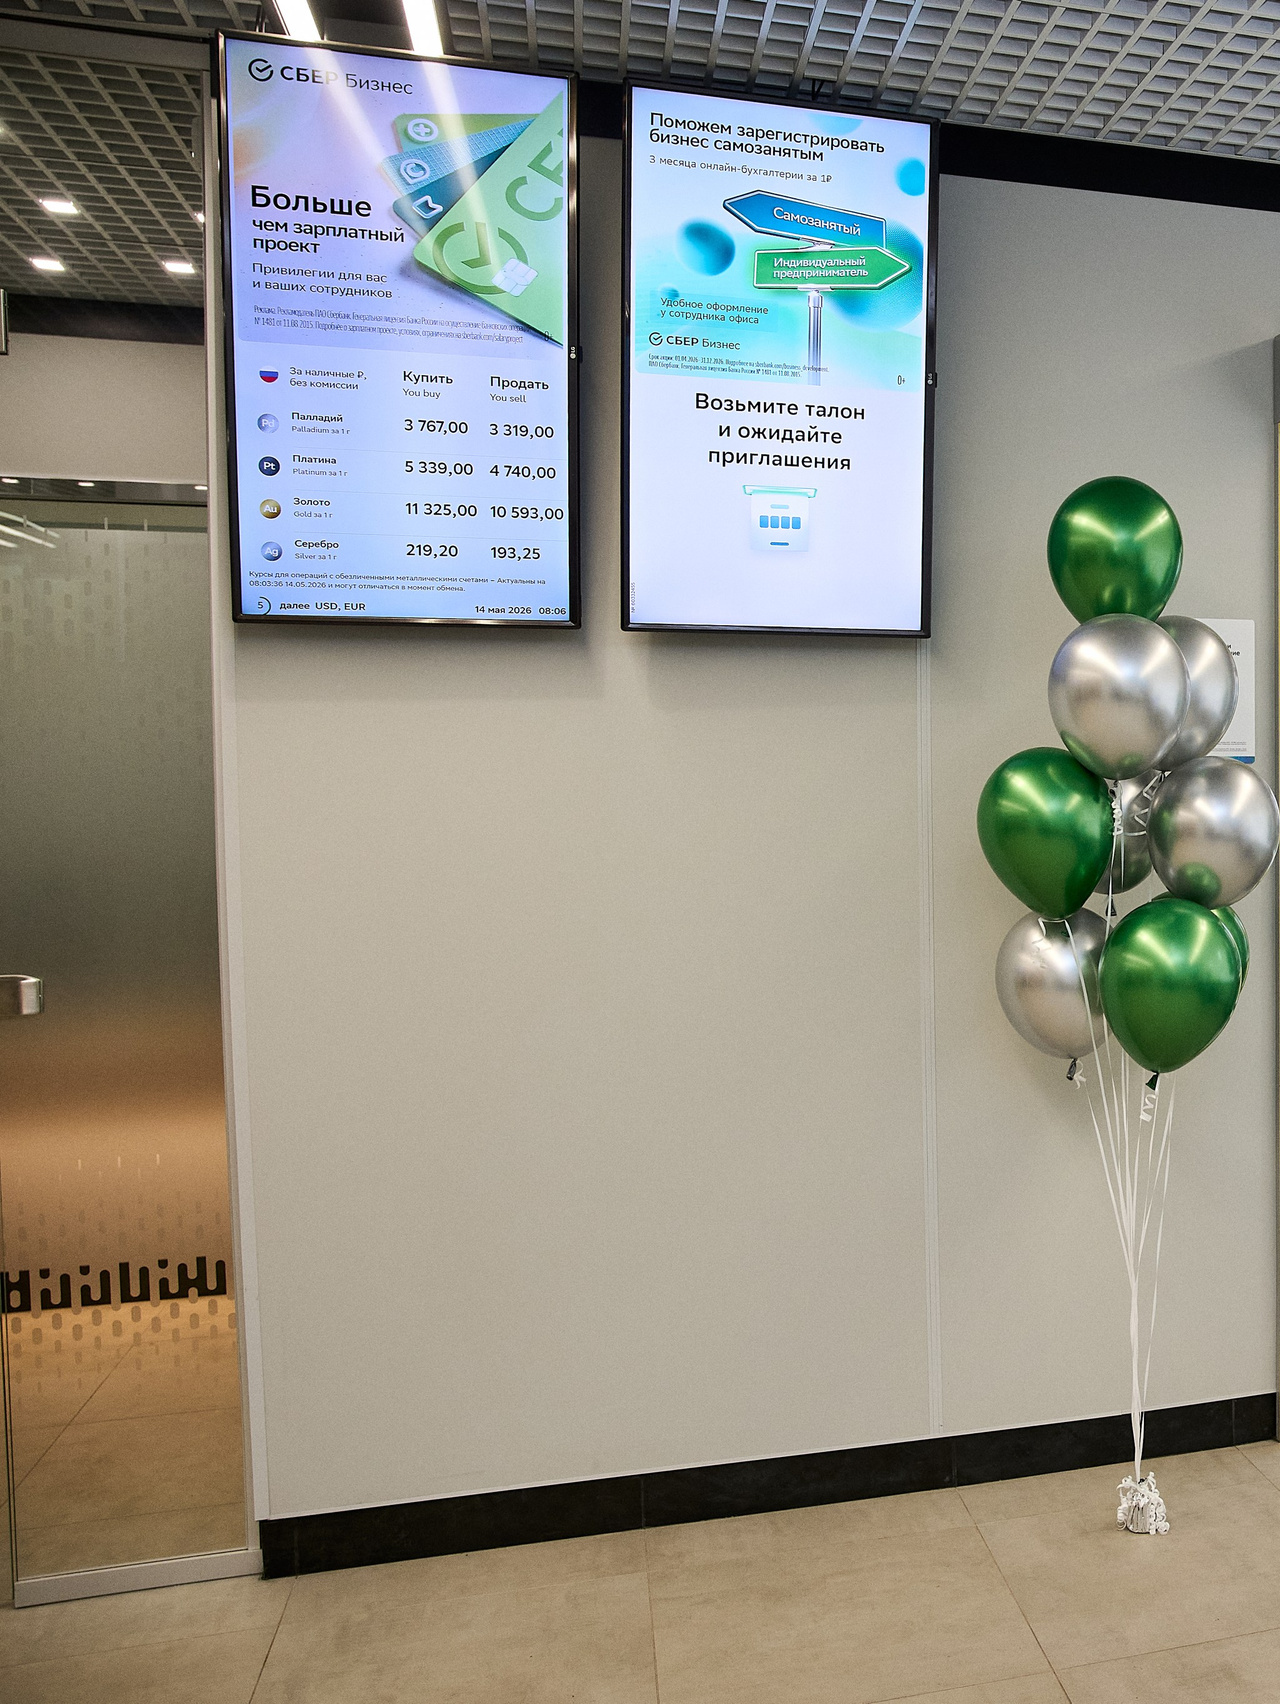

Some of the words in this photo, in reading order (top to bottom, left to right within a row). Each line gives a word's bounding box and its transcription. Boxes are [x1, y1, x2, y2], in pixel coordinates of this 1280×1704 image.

[280, 65, 338, 85] СБЕР
[345, 73, 413, 95] Бизнес
[650, 112, 732, 135] Поможем
[736, 124, 885, 153] зарегистрировать
[649, 128, 709, 149] бизнес
[714, 137, 824, 162] самозанятым
[649, 155, 656, 164] 3
[659, 157, 697, 170] месяца
[700, 160, 804, 180] онлайн-бухгалтерии
[807, 174, 817, 182] за
[250, 184, 372, 217] Больше
[773, 206, 861, 236] Самозанятый
[252, 218, 289, 234] чем
[293, 223, 405, 243] зарплатный
[253, 238, 320, 254] проект
[773, 256, 866, 268] Индивидуальный
[252, 263, 335, 279] Привилегии
[338, 270, 362, 283] для
[366, 273, 388, 284] вас
[773, 267, 869, 279] предприниматель
[252, 281, 261, 290] и
[265, 281, 306, 293] ваших
[309, 284, 393, 299] сотрудников
[660, 297, 703, 310] Удобное
[706, 301, 769, 315] оформление
[660, 310, 667, 319] у
[669, 309, 727, 323] сотрудника
[729, 313, 759, 325] офиса
[666, 335, 699, 347] СБЕР
[702, 338, 741, 350] Бизнес
[289, 367, 303, 377] За
[304, 369, 355, 379] наличные
[402, 370, 454, 386] Купить
[490, 376, 549, 391] Продать
[289, 378, 307, 389] без
[309, 380, 359, 390] комиссии
[402, 389, 422, 398] You
[423, 389, 441, 400] buy
[490, 393, 507, 403] You
[510, 394, 527, 403] sell
[695, 392, 799, 416] Возьмите
[805, 401, 865, 420] талон
[261, 419, 275, 428] Pd
[291, 412, 343, 423] Палладий
[291, 425, 330, 434] Palladium
[404, 419, 413, 432] 3
[418, 419, 469, 436] 767,00
[489, 423, 499, 436] 3
[503, 424, 555, 440] 319,00
[718, 425, 731, 438] и
[737, 426, 843, 444] ожидайте
[263, 462, 276, 470] Pt
[292, 454, 337, 465] Платина
[708, 450, 851, 470] приглашения
[292, 468, 327, 476] Platinum
[404, 461, 414, 473] 5
[418, 461, 474, 478] 339,00
[489, 465, 499, 478] 4
[503, 465, 557, 480] 740,00
[263, 504, 277, 513] Au
[293, 497, 331, 507] Золото
[405, 503, 420, 516] 11
[423, 503, 478, 519] 325,00
[490, 506, 507, 519] 10
[510, 507, 565, 522] 593,00
[264, 547, 279, 557] Ag
[294, 539, 340, 550] Серебро
[406, 544, 459, 559] 219,20
[490, 547, 541, 562] 193,25
[248, 580, 283, 588] 08:03:36
[291, 572, 328, 580] операций
[335, 573, 395, 581] обезличенными
[497, 577, 536, 585] Актуальны
[257, 601, 264, 609] 5
[280, 602, 310, 610] далее
[315, 602, 341, 611] USD,
[344, 603, 366, 611] EUR
[508, 606, 532, 614] 2026
[538, 607, 567, 615] 08:06
